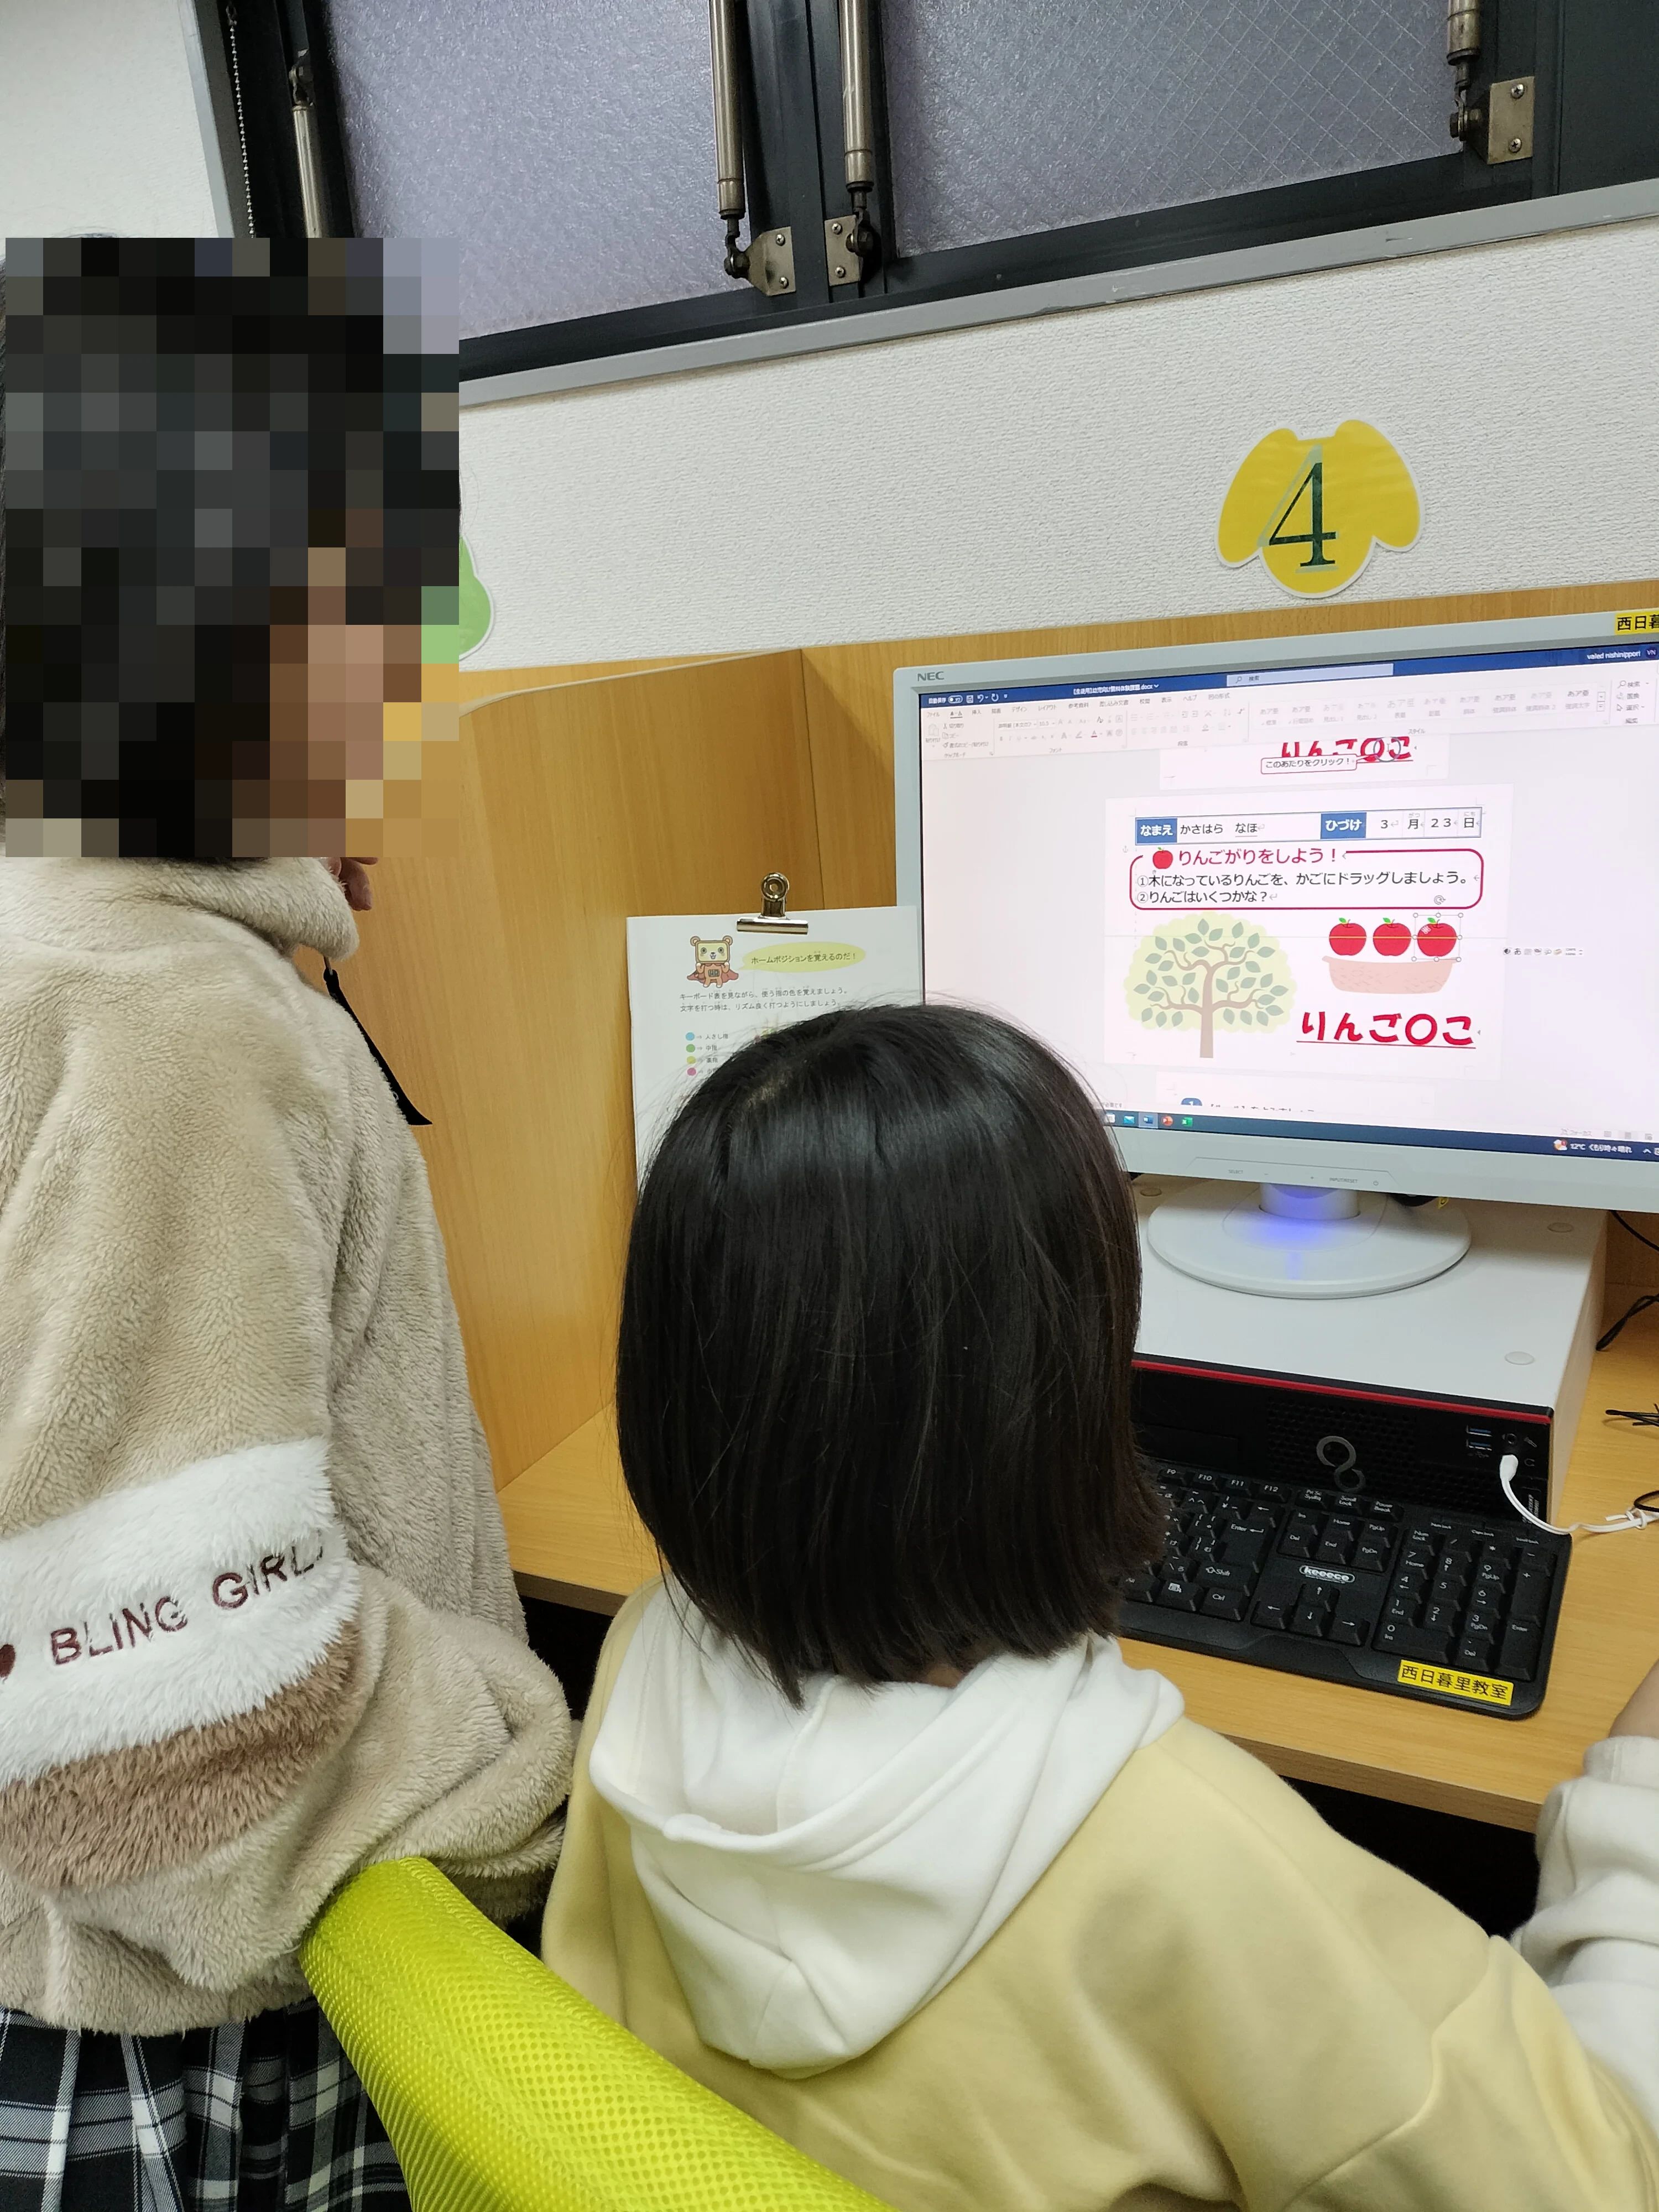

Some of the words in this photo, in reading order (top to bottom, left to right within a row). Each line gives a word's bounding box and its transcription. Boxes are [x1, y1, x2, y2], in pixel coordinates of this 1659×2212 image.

[1267, 461, 1337, 568] 4
[917, 671, 945, 682] NEC
[1265, 758, 1350, 769] このあたりをクリック！
[1140, 824, 1173, 837] なまえ
[1180, 823, 1223, 835] かさはら
[1235, 822, 1258, 833] なほ
[1325, 818, 1363, 832] ひづけ
[1380, 820, 1389, 830] 3
[1407, 818, 1419, 830] 月
[1464, 817, 1475, 829] 日
[1178, 848, 1335, 866] りんごがりをしよう！
[751, 952, 857, 964] ホームポジションを覚えるのだ！
[1198, 1473, 1213, 1481] F10
[1230, 1523, 1248, 1532] Enter
[1216, 1568, 1231, 1577] Shift
[49, 1595, 189, 1666] BLING
[211, 1529, 324, 1609] GIRL
[1478, 1589, 1487, 1598] 6
[1391, 1608, 1405, 1616] End
[1472, 1614, 1480, 1623] 3
[1464, 1649, 1477, 1657] Del
[1401, 1665, 1509, 1700] 西日暮里教室
